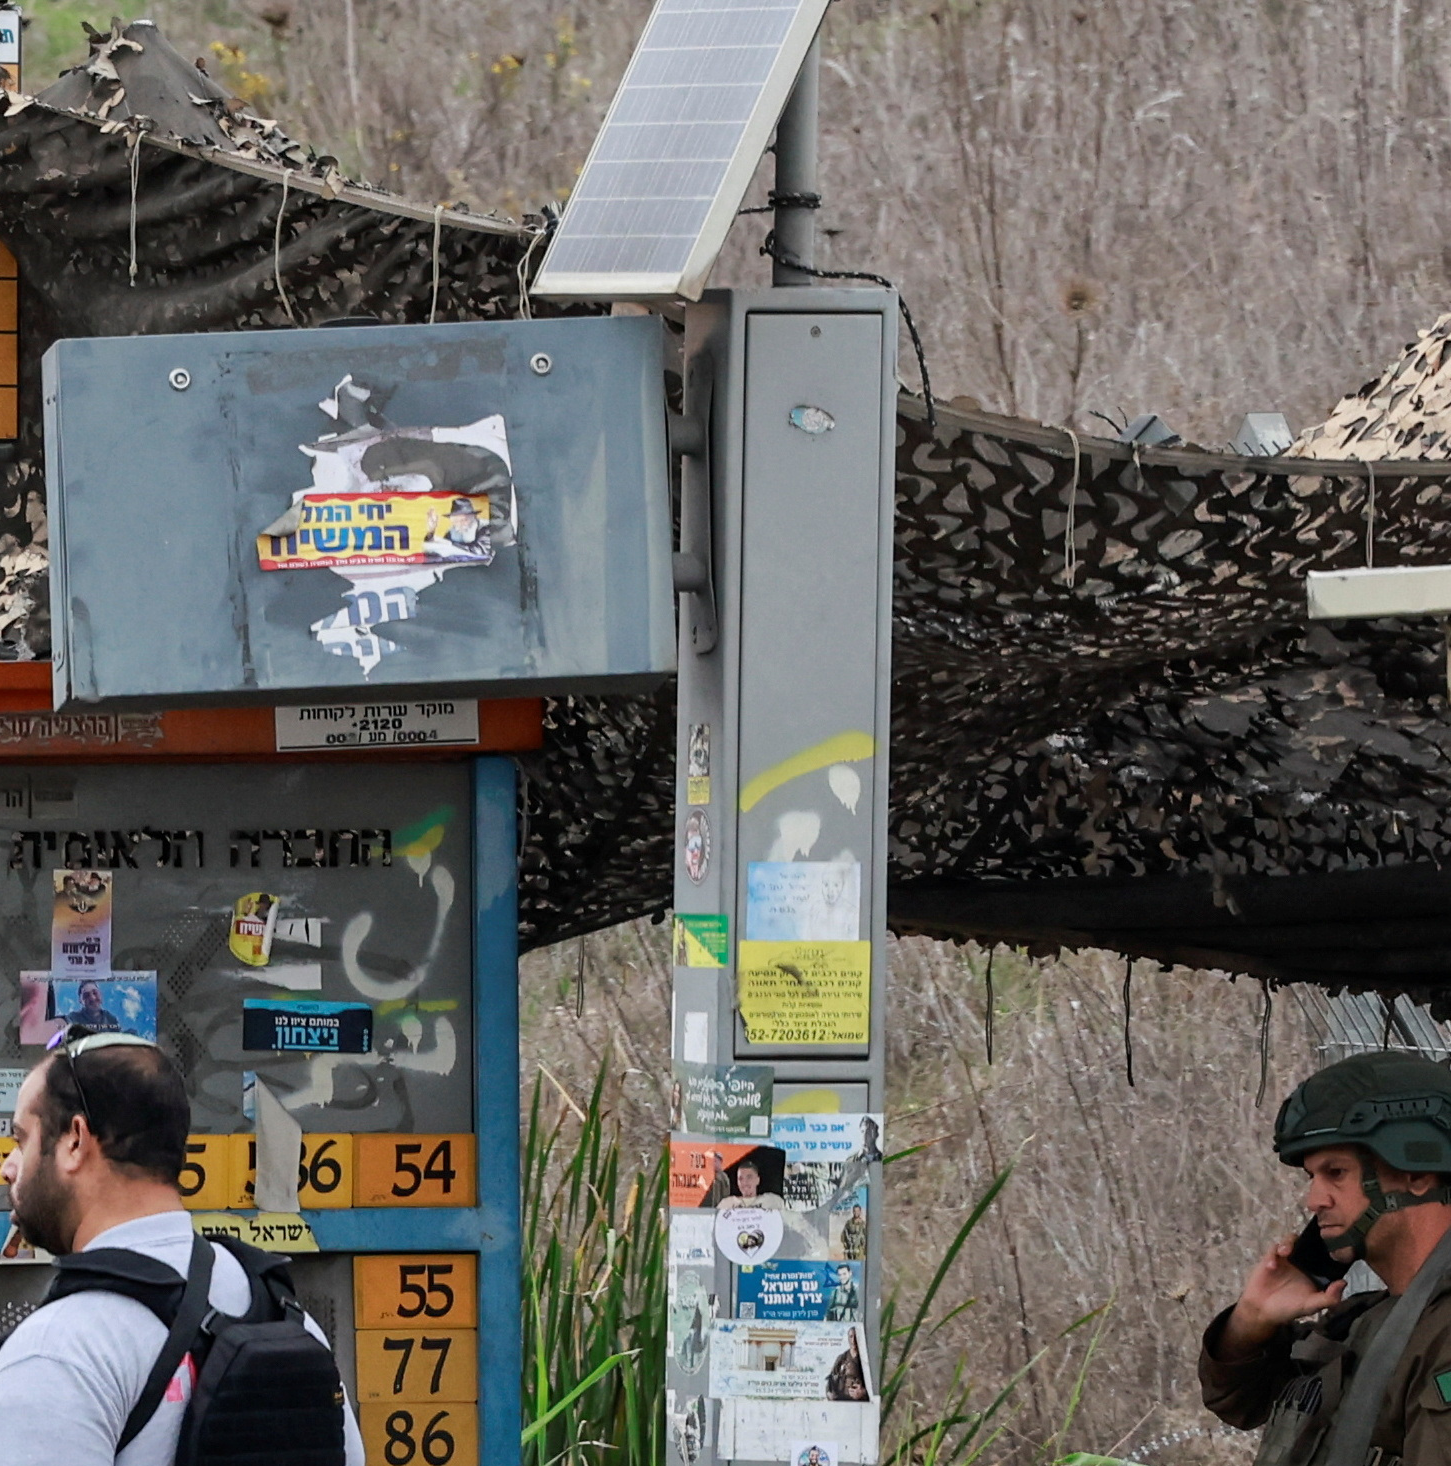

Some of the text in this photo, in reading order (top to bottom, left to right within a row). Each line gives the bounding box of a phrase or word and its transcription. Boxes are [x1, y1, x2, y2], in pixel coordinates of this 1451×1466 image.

[302, 504, 392, 523] יחי המל
[271, 525, 409, 557] המשיח
[299, 703, 455, 721] מוקד שרות לקוחות
[10, 827, 203, 869] הלאומית
[230, 830, 392, 868] החברה
[838, 980, 862, 989] קונים
[275, 1016, 288, 1025] לנו
[309, 1017, 339, 1026] במותם
[809, 1142, 852, 1150] עושים עד
[391, 1140, 455, 1197] 54
[249, 1220, 312, 1242] ישראל
[396, 1264, 454, 1318] 55
[762, 1279, 818, 1292] עם ישראל
[797, 1293, 823, 1307] צריך
[382, 1337, 452, 1395] 77
[384, 1411, 455, 1466] 86
